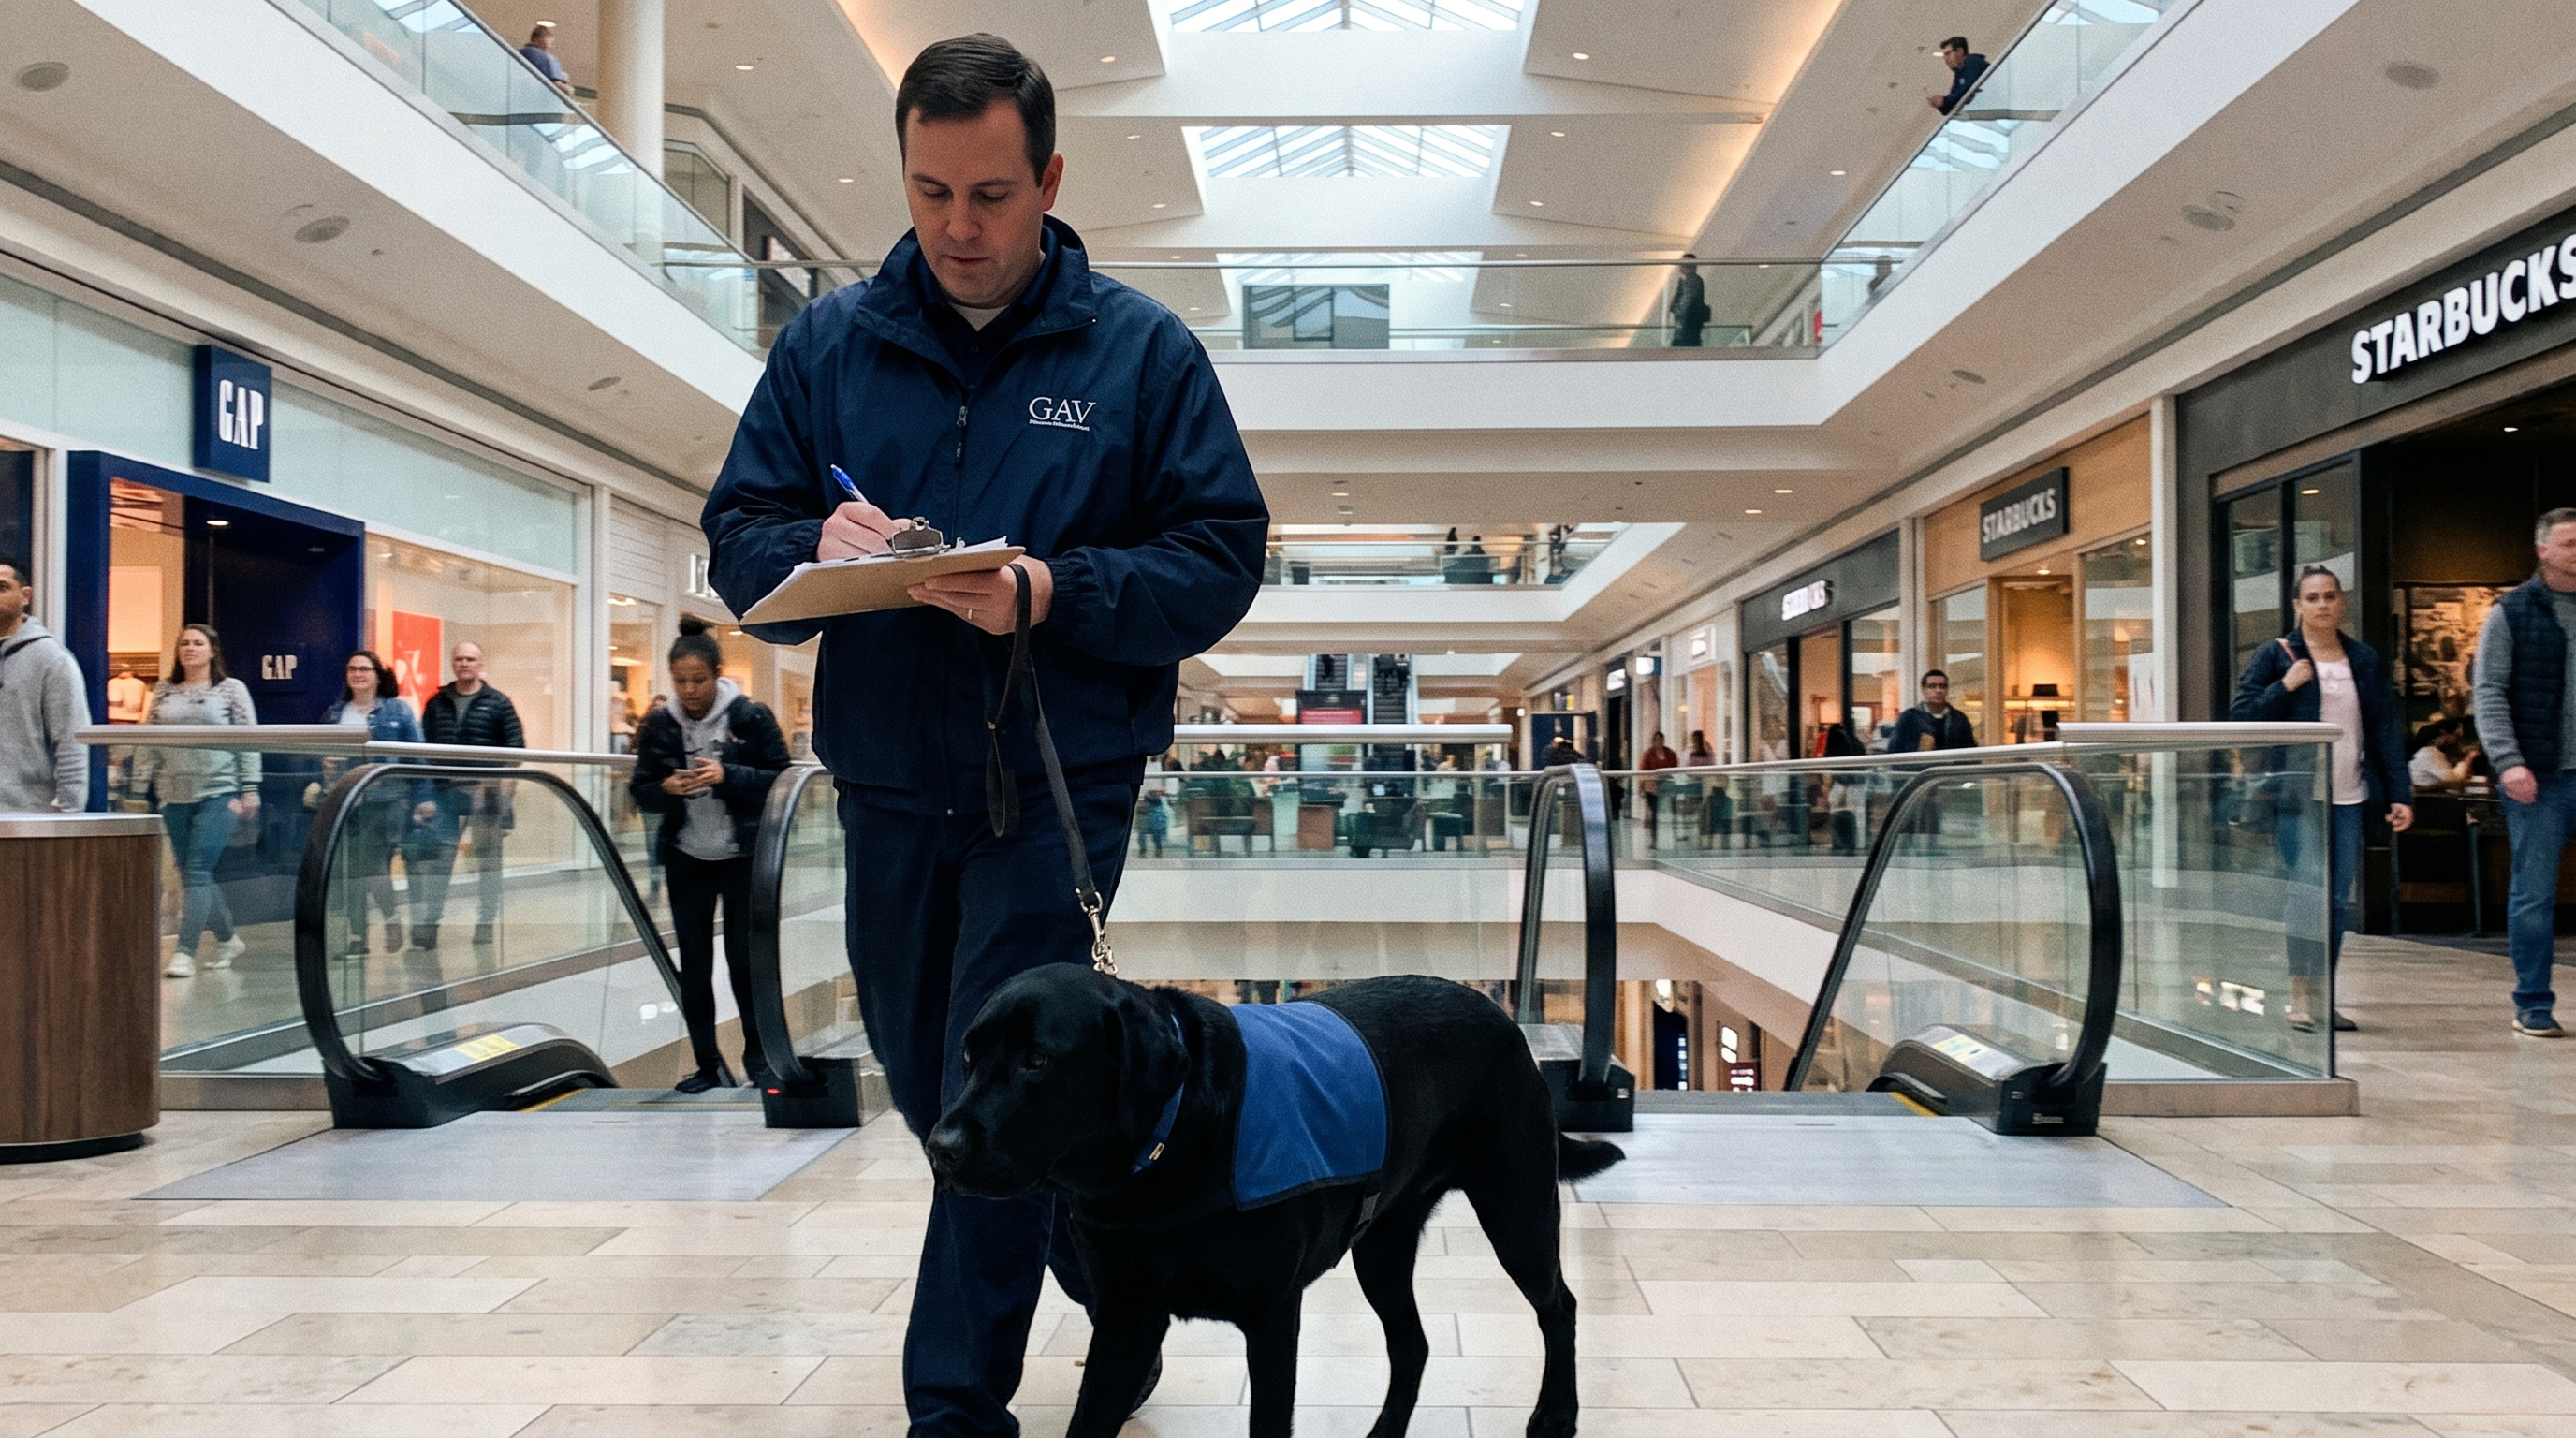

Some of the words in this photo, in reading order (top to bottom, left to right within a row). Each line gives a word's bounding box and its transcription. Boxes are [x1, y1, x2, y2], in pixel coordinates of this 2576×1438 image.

[2351, 234, 2576, 384] STARBUCKS
[219, 379, 264, 449] GAP
[1029, 396, 1097, 424] GAV
[262, 654, 298, 680] GAP
